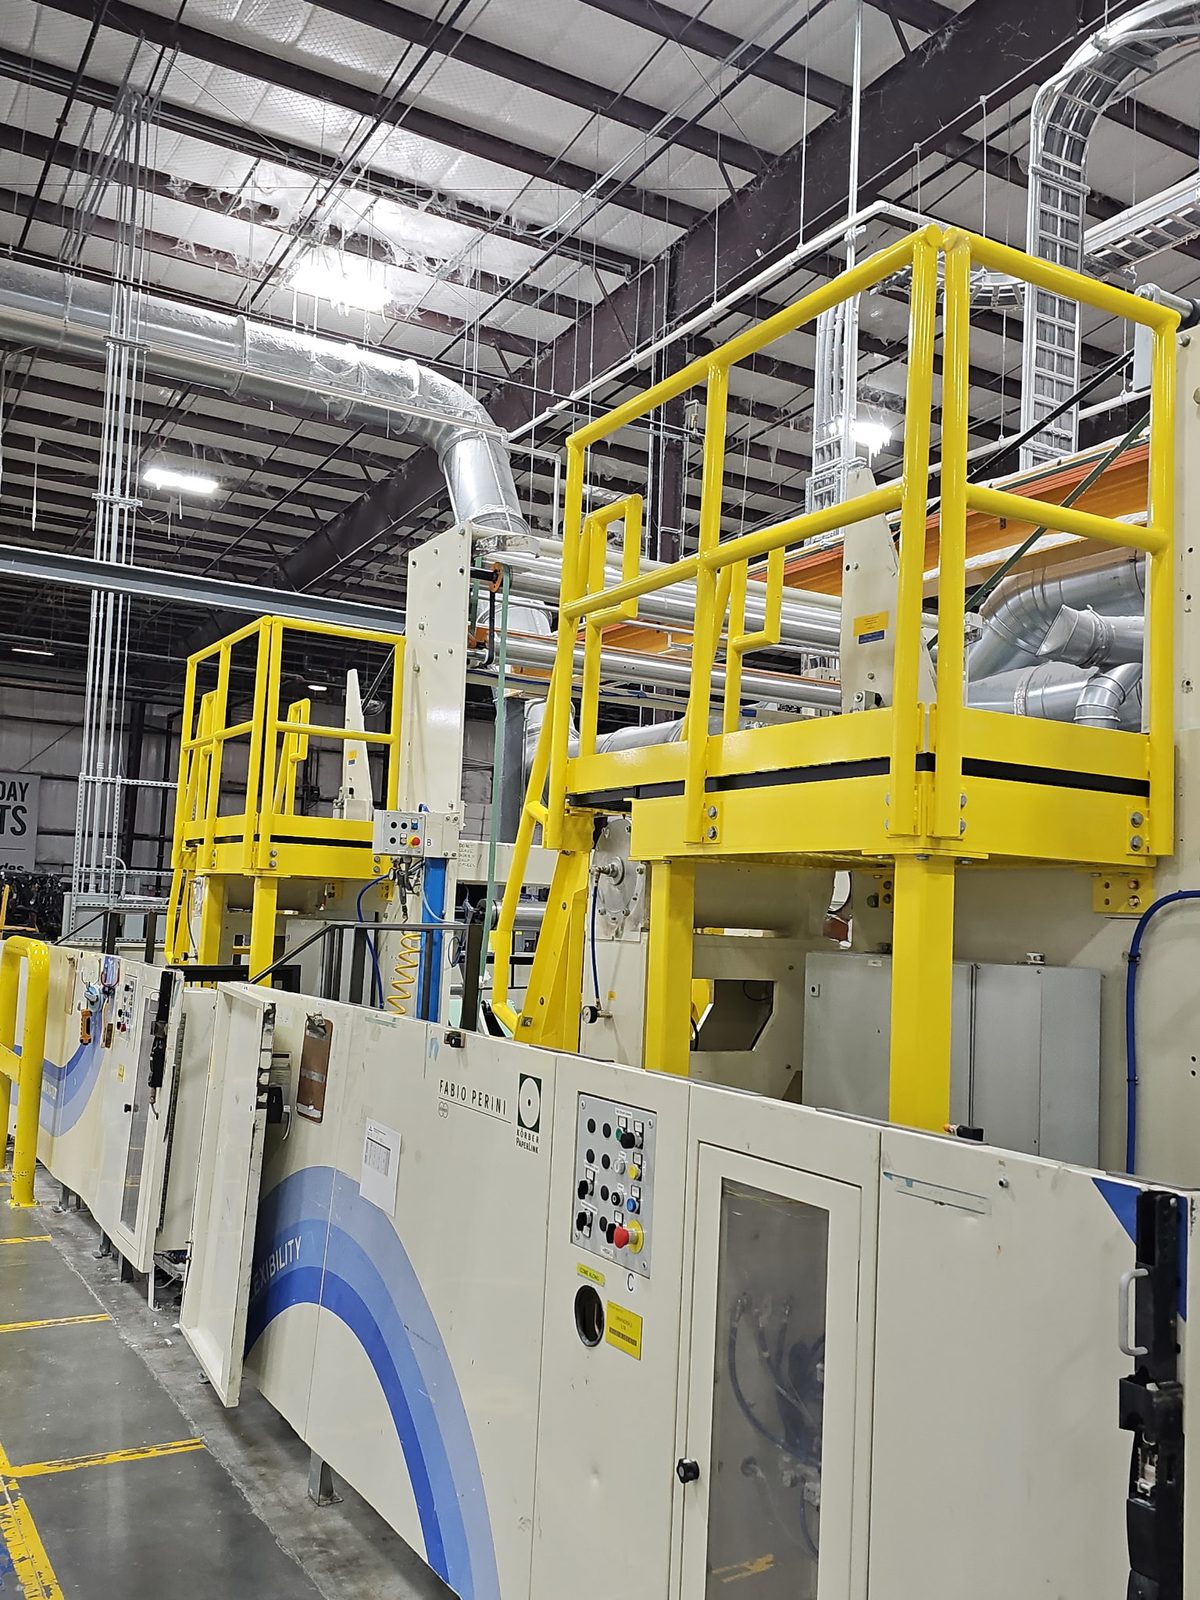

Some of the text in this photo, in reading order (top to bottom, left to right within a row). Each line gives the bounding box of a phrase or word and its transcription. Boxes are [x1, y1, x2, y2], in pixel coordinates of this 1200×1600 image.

[439, 1079, 506, 1115] FABIO PERINI
[249, 1235, 302, 1300] EXIBILITY
[627, 1272, 636, 1292] C
